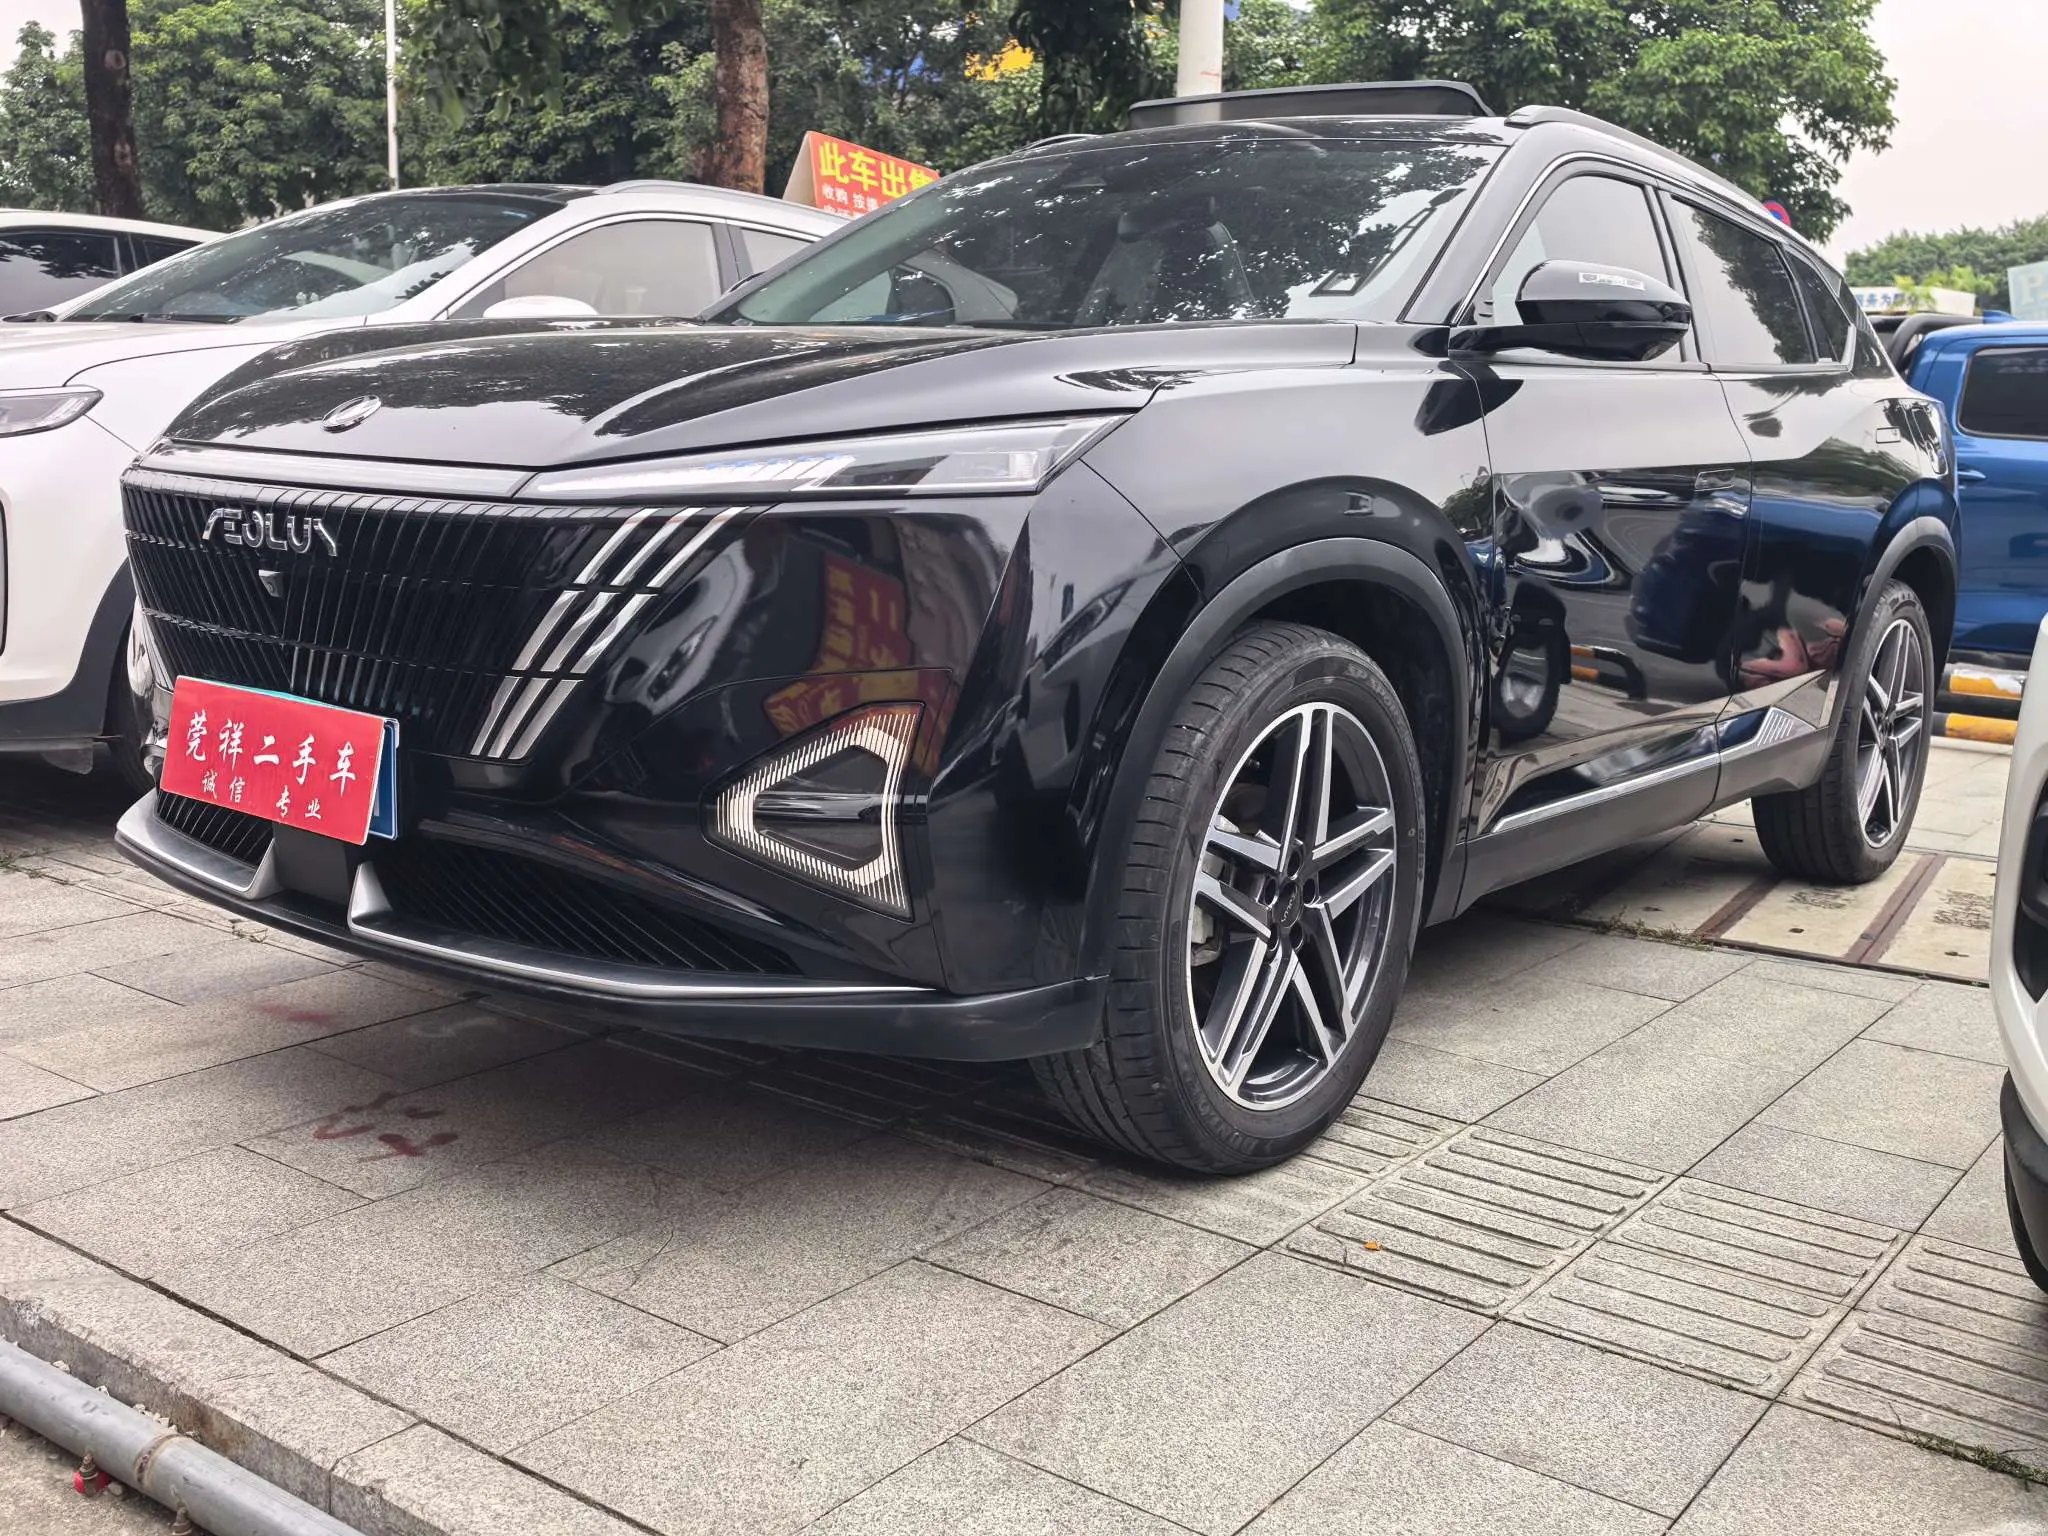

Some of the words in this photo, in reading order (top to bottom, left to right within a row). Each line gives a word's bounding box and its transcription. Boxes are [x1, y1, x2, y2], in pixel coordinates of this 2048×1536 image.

[185, 709, 356, 797] 莞祥二手车
[202, 769, 245, 803] 诚信
[275, 785, 322, 820] 专业
